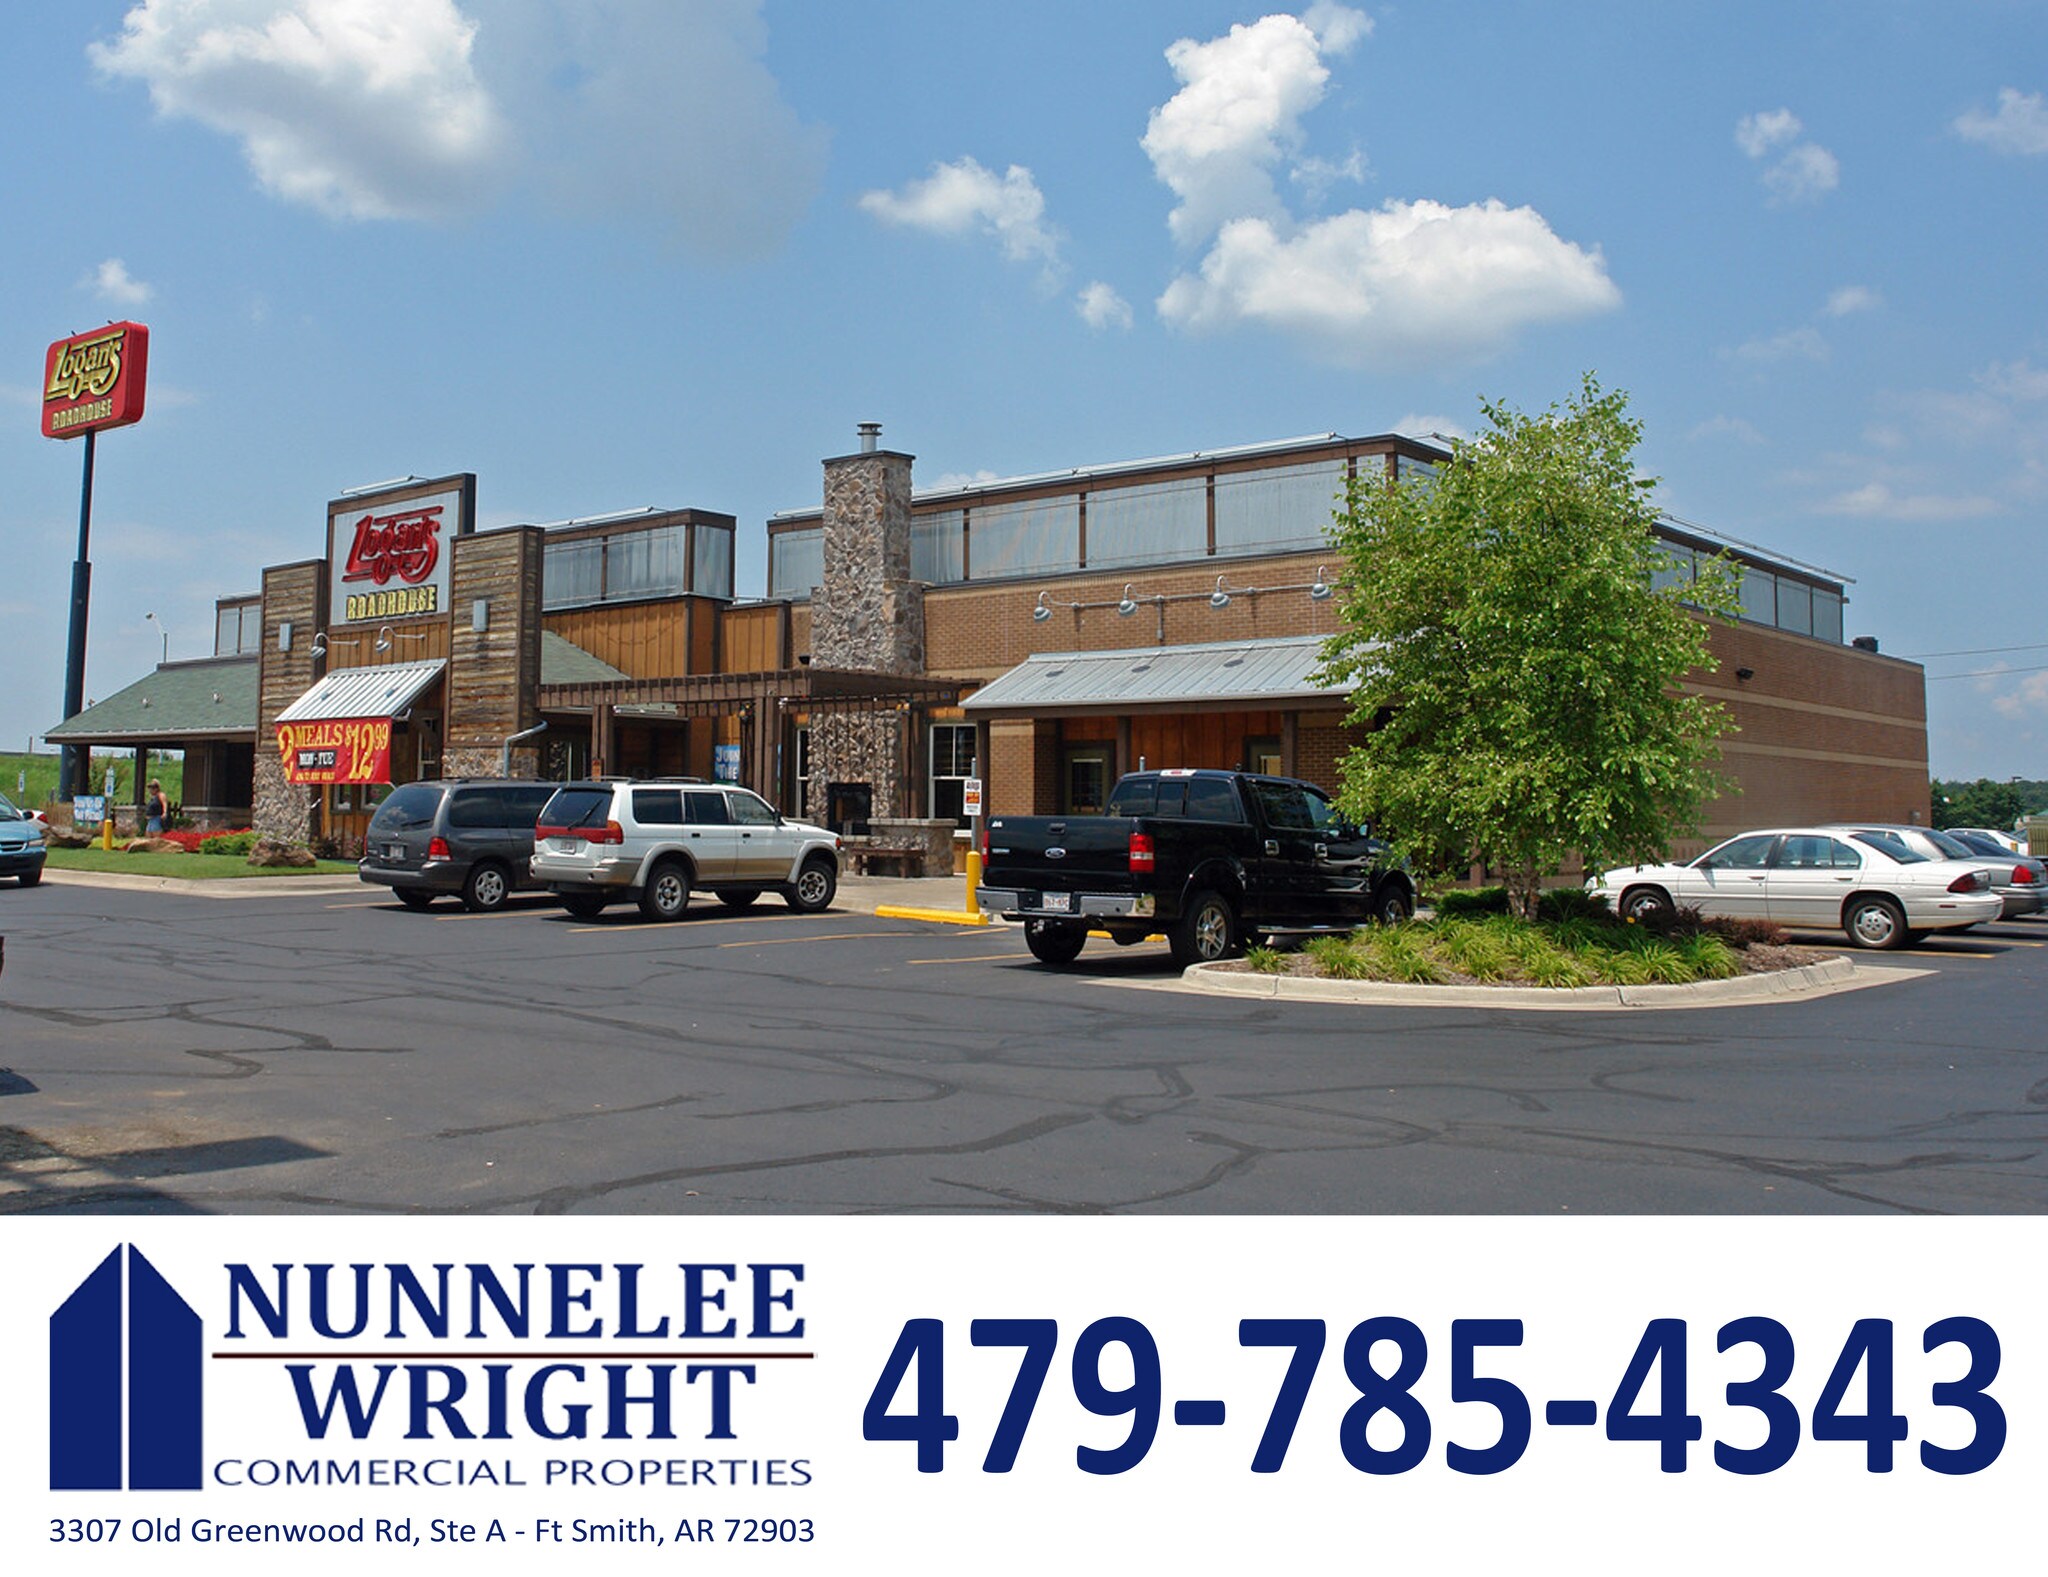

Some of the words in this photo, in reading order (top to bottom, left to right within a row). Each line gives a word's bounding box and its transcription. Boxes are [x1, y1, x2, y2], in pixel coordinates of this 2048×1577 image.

[44, 329, 126, 401] Logan's
[52, 398, 112, 431] ROADHOUSE
[341, 505, 444, 585] Logan's
[346, 584, 438, 621] ROADHOUSE
[278, 725, 295, 781] 2
[295, 723, 344, 749] MEALS
